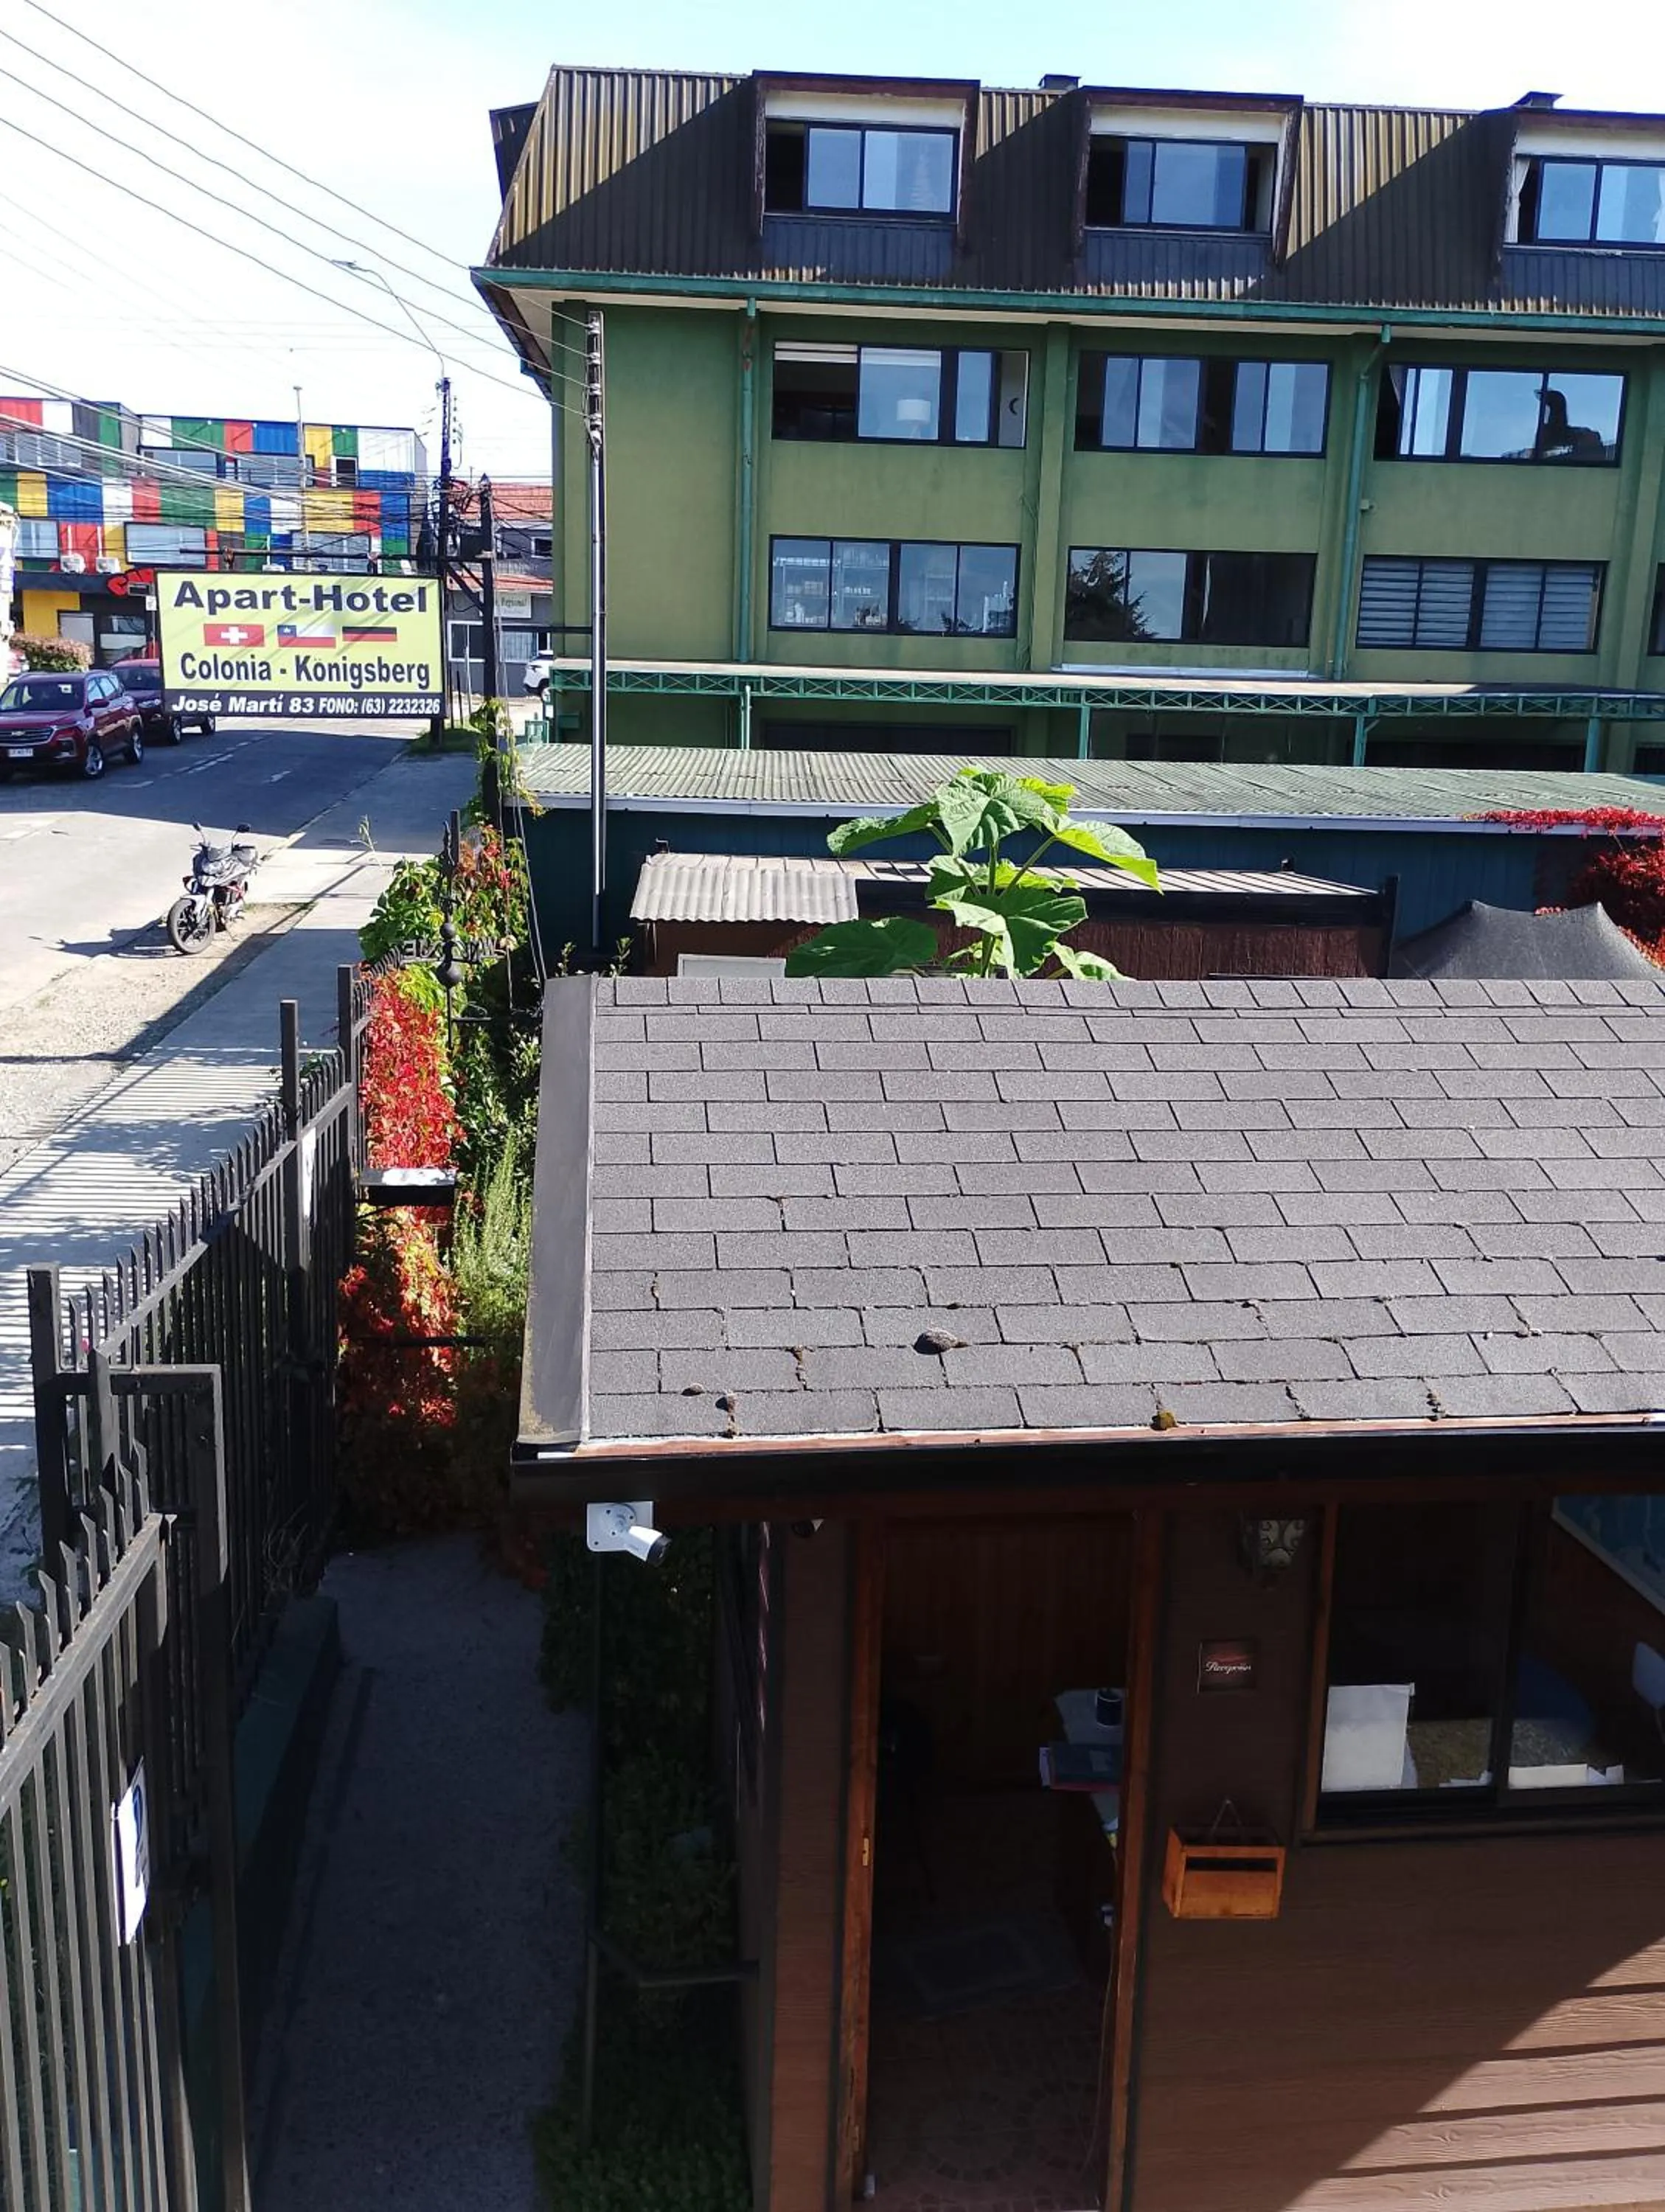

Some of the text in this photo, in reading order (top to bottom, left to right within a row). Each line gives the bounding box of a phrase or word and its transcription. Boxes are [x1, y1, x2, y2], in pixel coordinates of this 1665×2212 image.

[173, 580, 428, 615] Apart-Hotel
[180, 652, 271, 681] Colonia
[172, 692, 440, 714] José Martí 83 FONO: (63) 2232326
